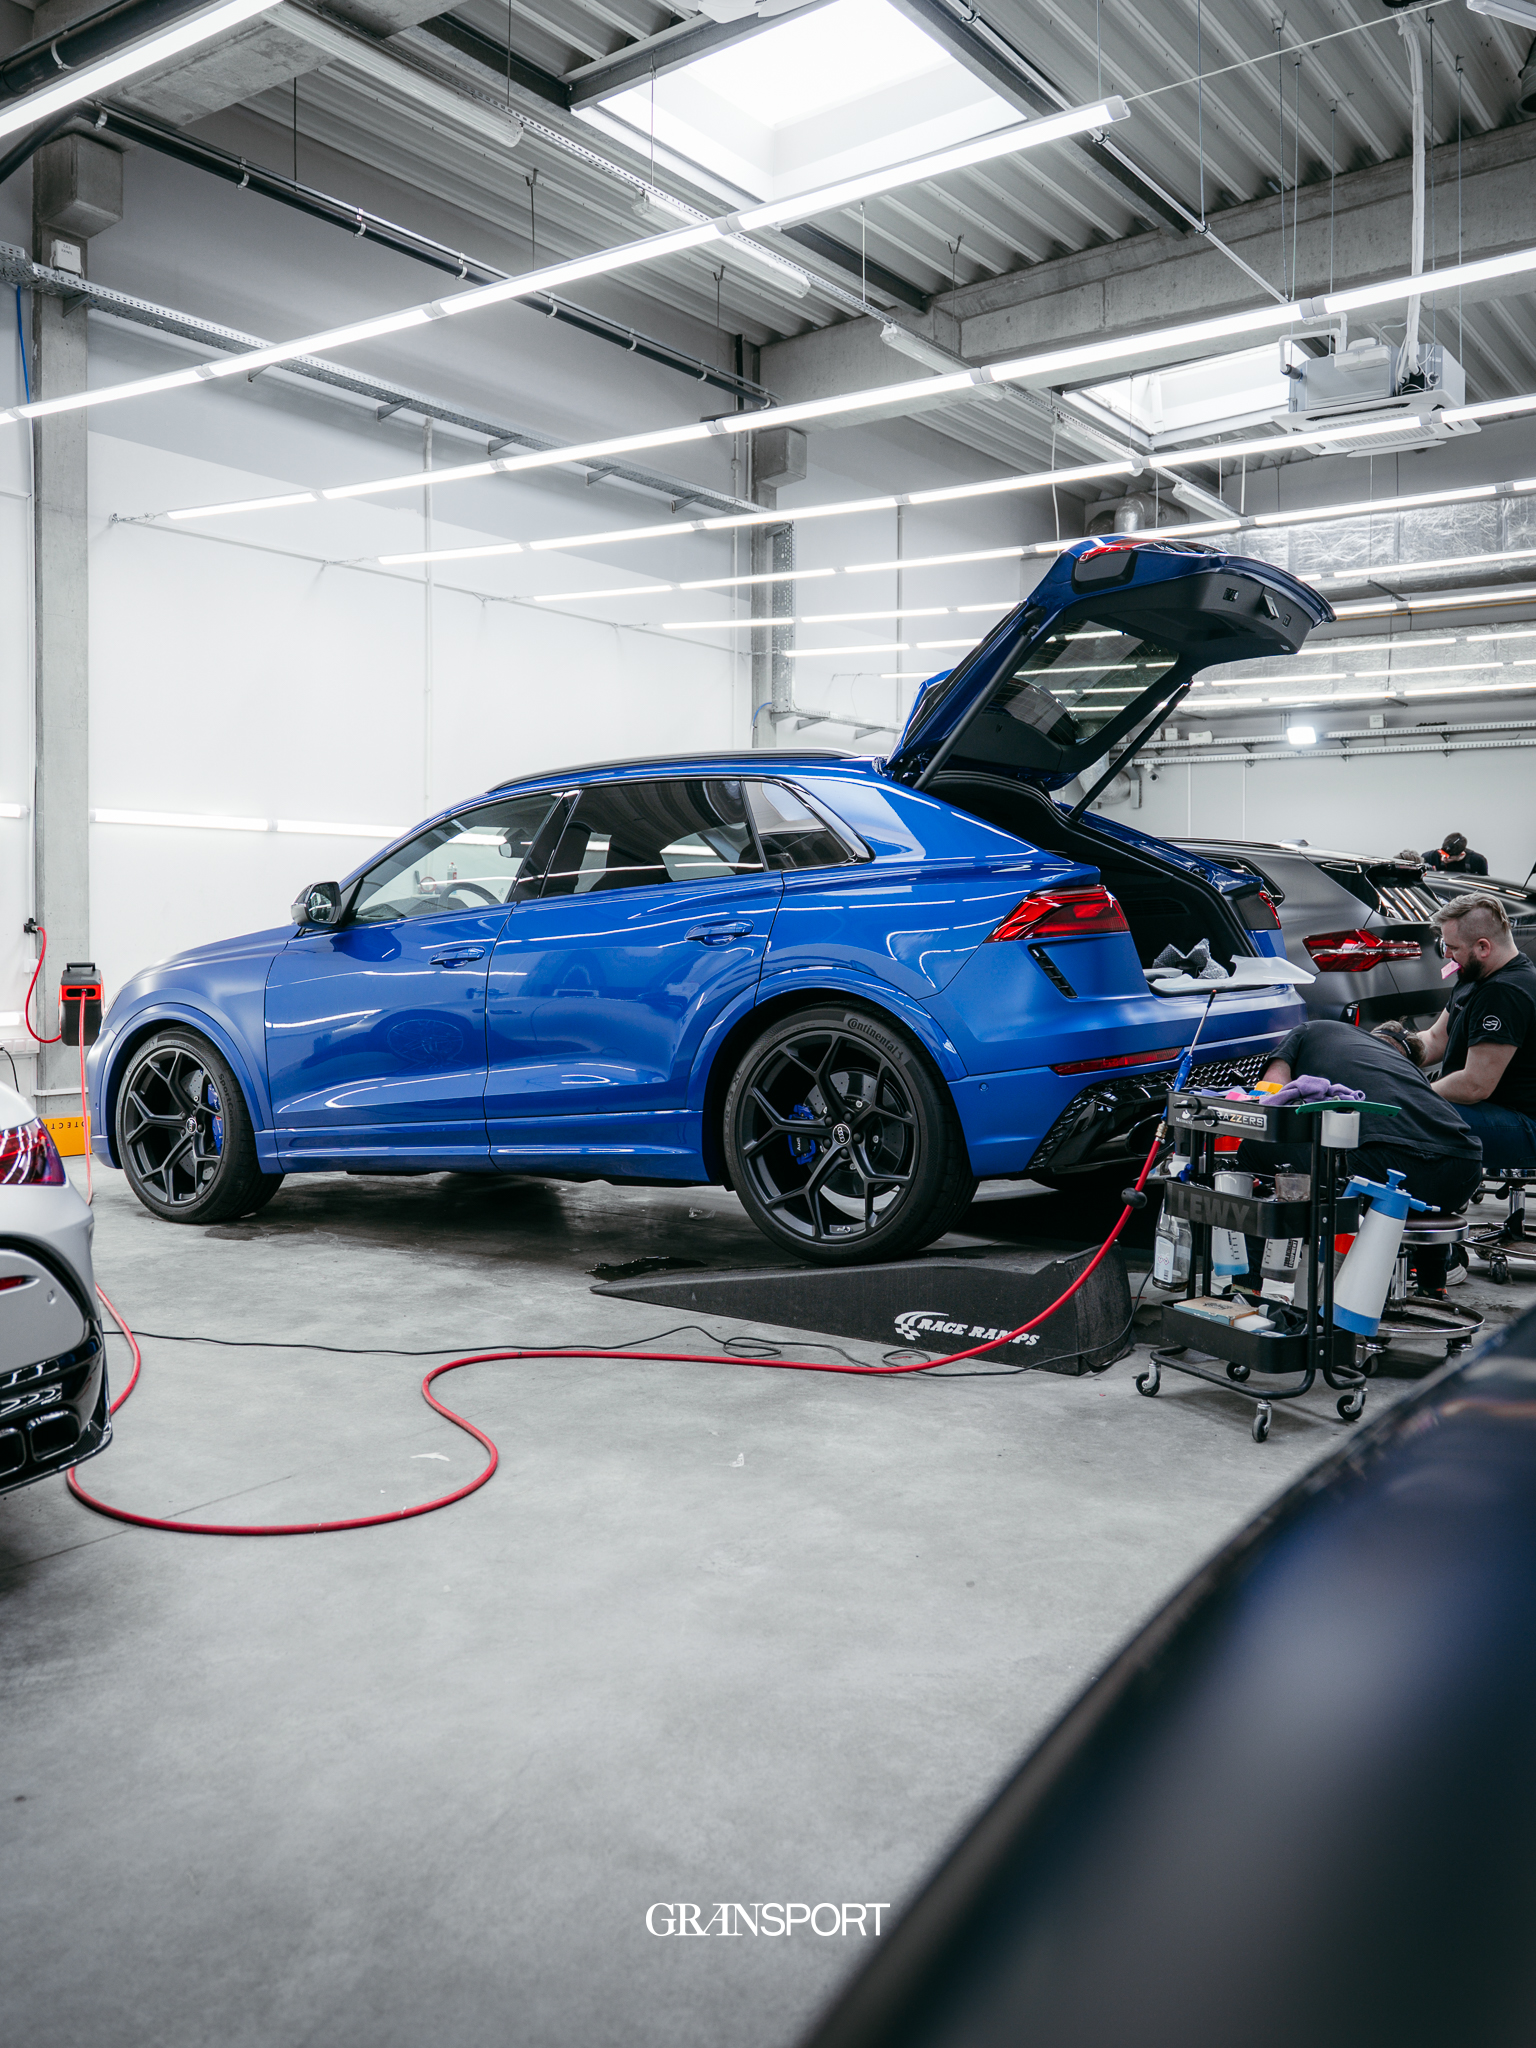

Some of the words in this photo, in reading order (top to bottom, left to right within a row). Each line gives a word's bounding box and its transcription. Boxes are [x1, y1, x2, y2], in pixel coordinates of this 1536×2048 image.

[847, 1017, 899, 1054] Continental
[1178, 1190, 1250, 1229] LEWY
[917, 1318, 968, 1335] RACE
